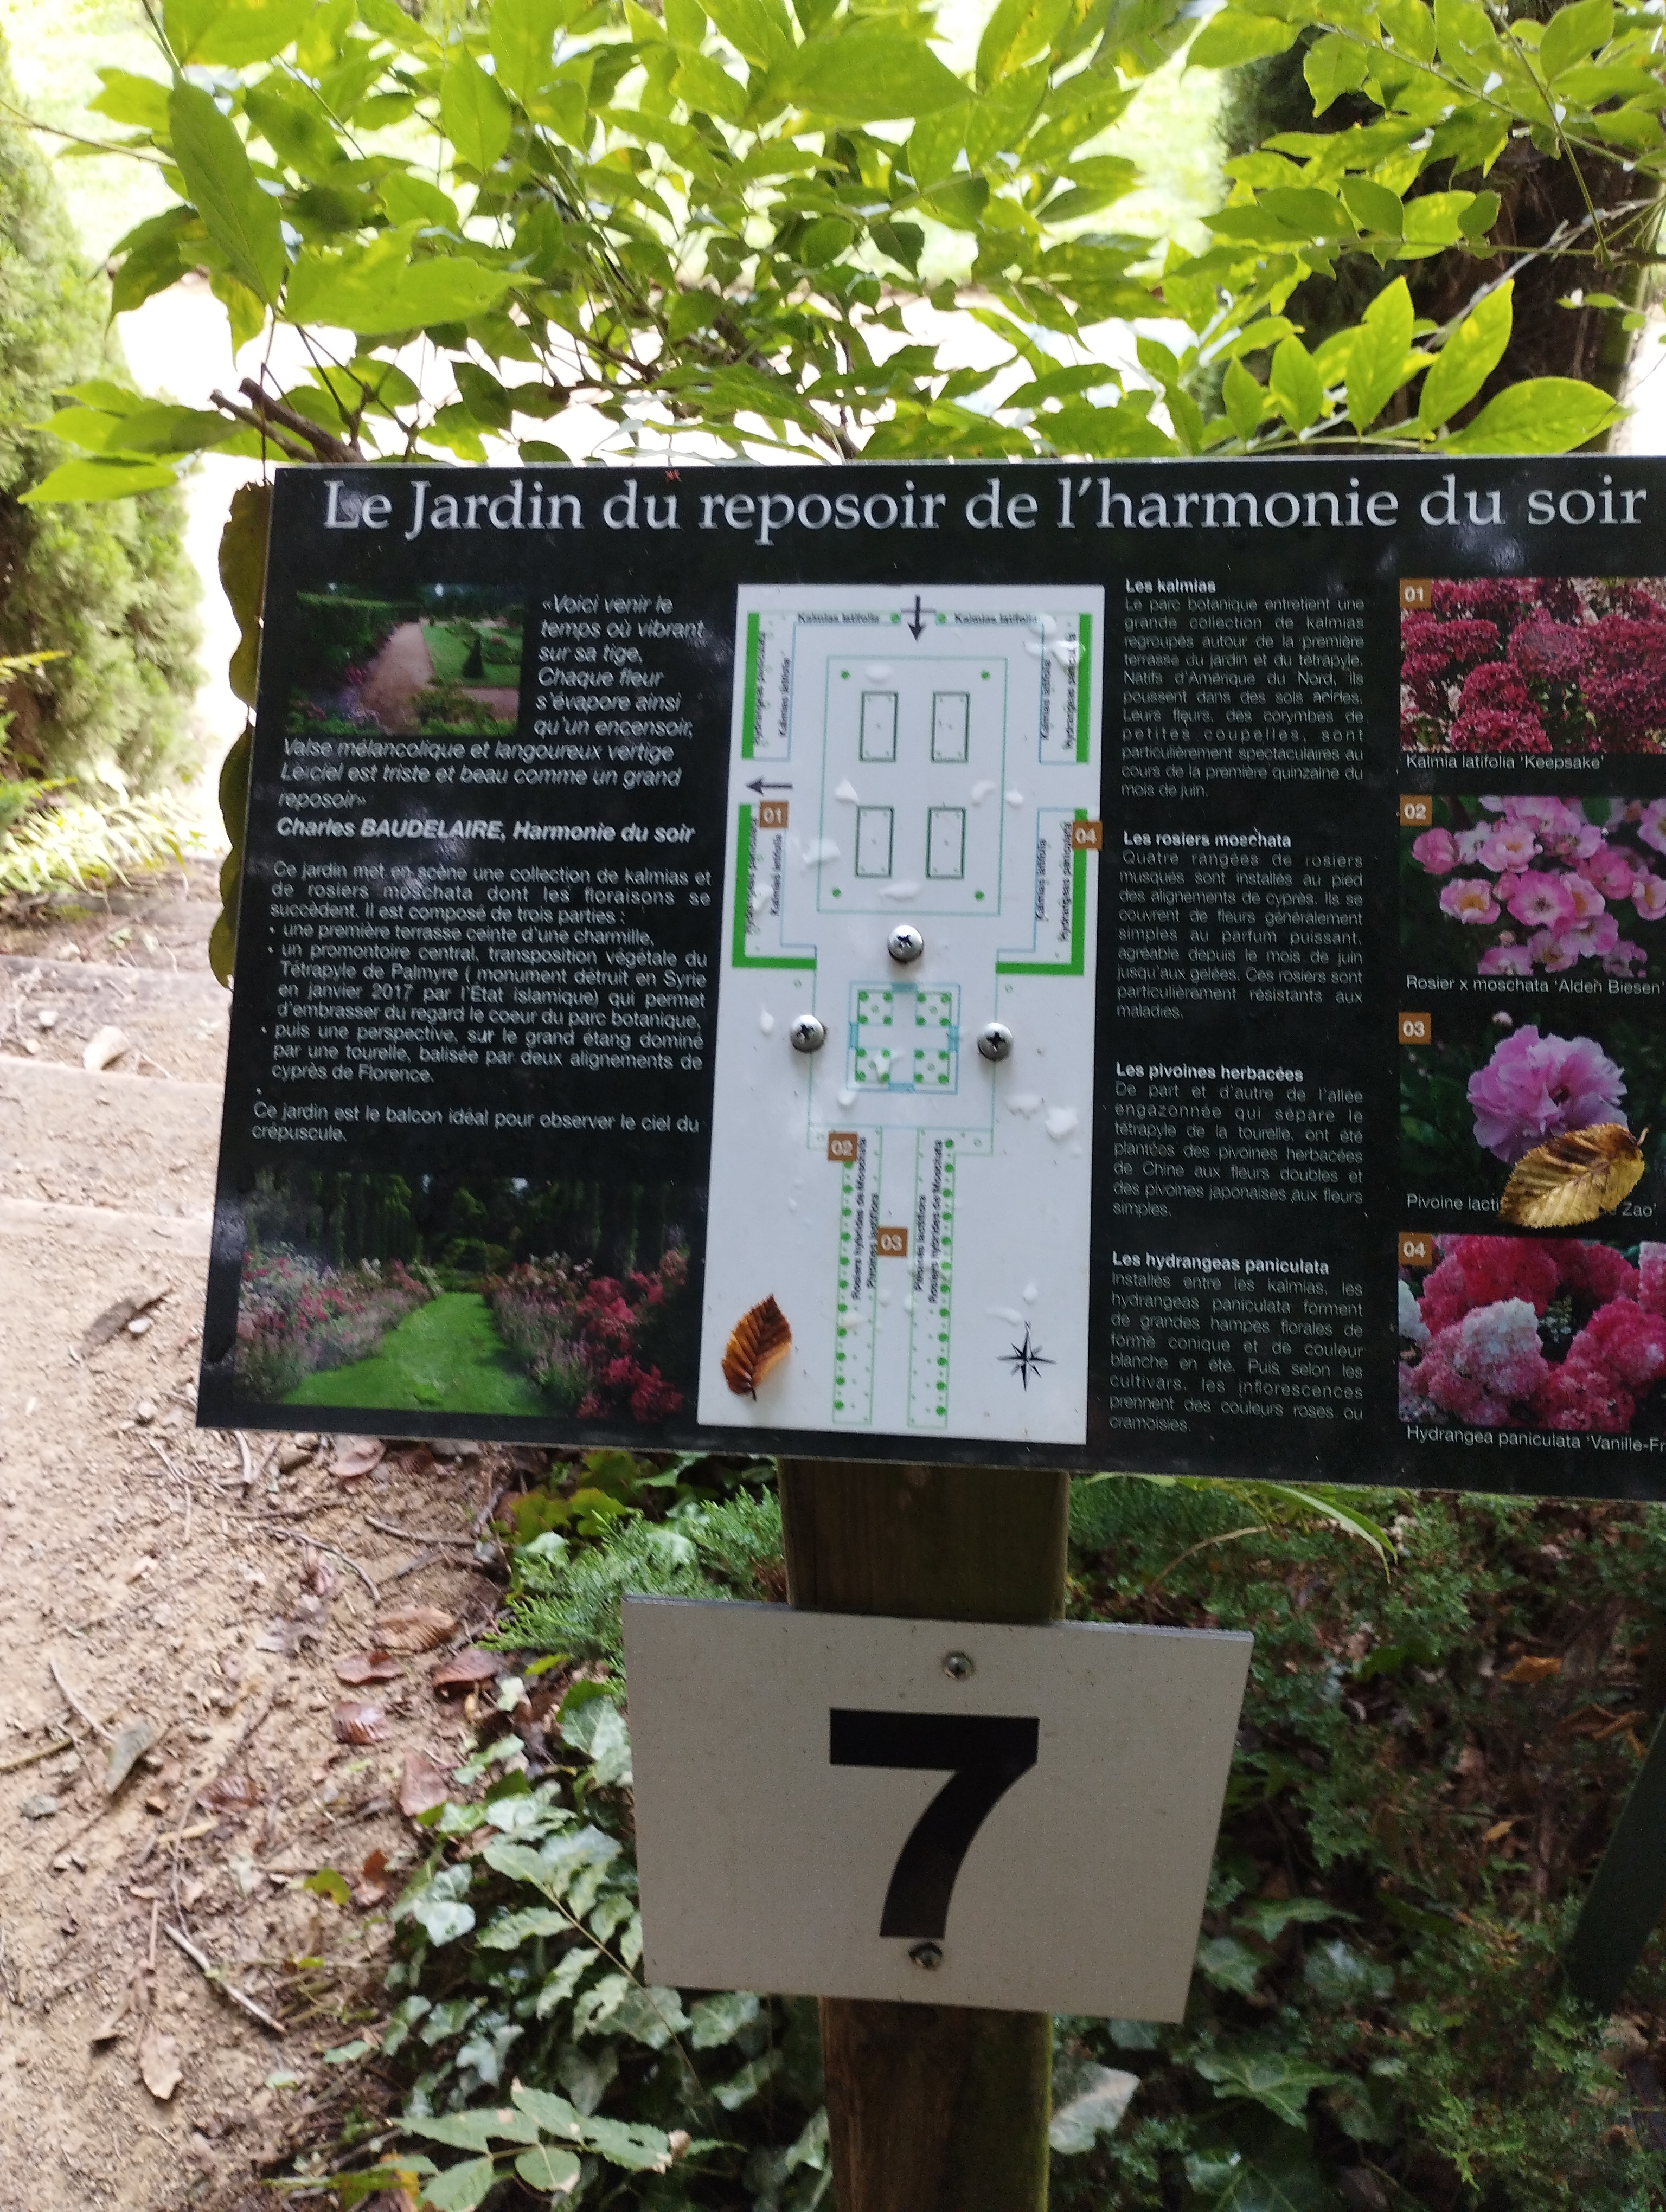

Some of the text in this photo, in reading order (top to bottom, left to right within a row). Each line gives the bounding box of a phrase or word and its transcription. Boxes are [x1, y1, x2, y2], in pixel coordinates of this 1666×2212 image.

[324, 473, 1647, 546] Le Jardin du reposoir de l'harmonie du soir
[1125, 578, 1216, 594] Les kalmias
[1404, 587, 1425, 602] 01
[605, 594, 652, 614] venir
[656, 595, 673, 614] le
[797, 613, 840, 625] Kalmias
[954, 613, 997, 625] Kalmias
[541, 619, 705, 641] temps où vibrant
[539, 646, 572, 663] sur
[575, 647, 598, 663] sa
[538, 666, 664, 691] Chaque fleur
[536, 691, 682, 715] s'évapore ainsi
[534, 716, 590, 739] qu'un
[1122, 728, 1190, 743] petites
[1321, 729, 1363, 743] sont
[284, 737, 674, 766] Valse mélancolique et langoureux vertige
[1406, 754, 1604, 771] Kalmia latifolia 'Keepsake'
[281, 762, 683, 790] Le ciel est triste et beau comme un grand
[762, 807, 783, 824] 01
[1404, 805, 1426, 820] 02
[277, 816, 695, 843] Charles BAUDELAIRE, Harmonie du soir
[1075, 828, 1097, 844] 04
[1124, 831, 1291, 848] Les rosiers moschata
[1123, 850, 1179, 865] Quatre
[1272, 852, 1292, 867] de
[273, 860, 297, 877] Ce
[302, 862, 348, 881] jardin
[353, 863, 384, 878] met
[418, 863, 467, 881] scène
[474, 867, 505, 882] une
[510, 866, 591, 884] collection
[597, 867, 619, 884] de
[626, 867, 689, 886] kalmias
[695, 870, 712, 886] et
[1194, 871, 1226, 885] sont
[1303, 874, 1321, 887] au
[283, 924, 313, 937] une
[318, 922, 390, 940] première
[396, 924, 462, 941] terrasse
[466, 925, 517, 942] ceinte
[521, 926, 570, 943] d'une
[281, 944, 302, 957] un
[310, 943, 411, 960] promontoire
[488, 947, 597, 966] transposition
[605, 948, 677, 969] végétale
[685, 950, 707, 967] du
[1406, 974, 1455, 991] Rosier
[1459, 980, 1468, 990] x
[1473, 978, 1549, 993] moschata
[1608, 979, 1665, 995] Biesen'
[278, 983, 299, 998] en
[308, 982, 363, 1001] janvier
[371, 983, 414, 1002] 2017
[424, 987, 451, 1004] par
[461, 982, 504, 1003] l'État
[608, 989, 636, 1008] qui
[645, 991, 706, 1009] permet
[1403, 1021, 1425, 1037] 03
[273, 1044, 302, 1060] par
[307, 1046, 339, 1059] une
[419, 1045, 479, 1064] balisée
[486, 1050, 514, 1067] par
[520, 1050, 563, 1065] deux
[570, 1050, 674, 1071] alignements
[680, 1053, 703, 1071] de
[272, 1062, 328, 1082] cyprès
[332, 1064, 354, 1080] de
[1116, 1062, 1303, 1082] Les pivoines herbacées
[254, 1101, 699, 1133] Ce jardin est le balcon idéal pour observer le ciel du
[1235, 1106, 1261, 1122] qui
[1348, 1108, 1363, 1123] le
[1407, 1193, 1463, 1211] Pivoine
[1468, 1193, 1502, 1212] lacti
[1403, 1243, 1425, 1258] 04
[1112, 1251, 1329, 1275] Les hydrangeas paniculata
[1407, 1425, 1666, 1452] Hydrangea paniculata 'Vanille-Fr
[830, 1707, 1040, 1939] 7
